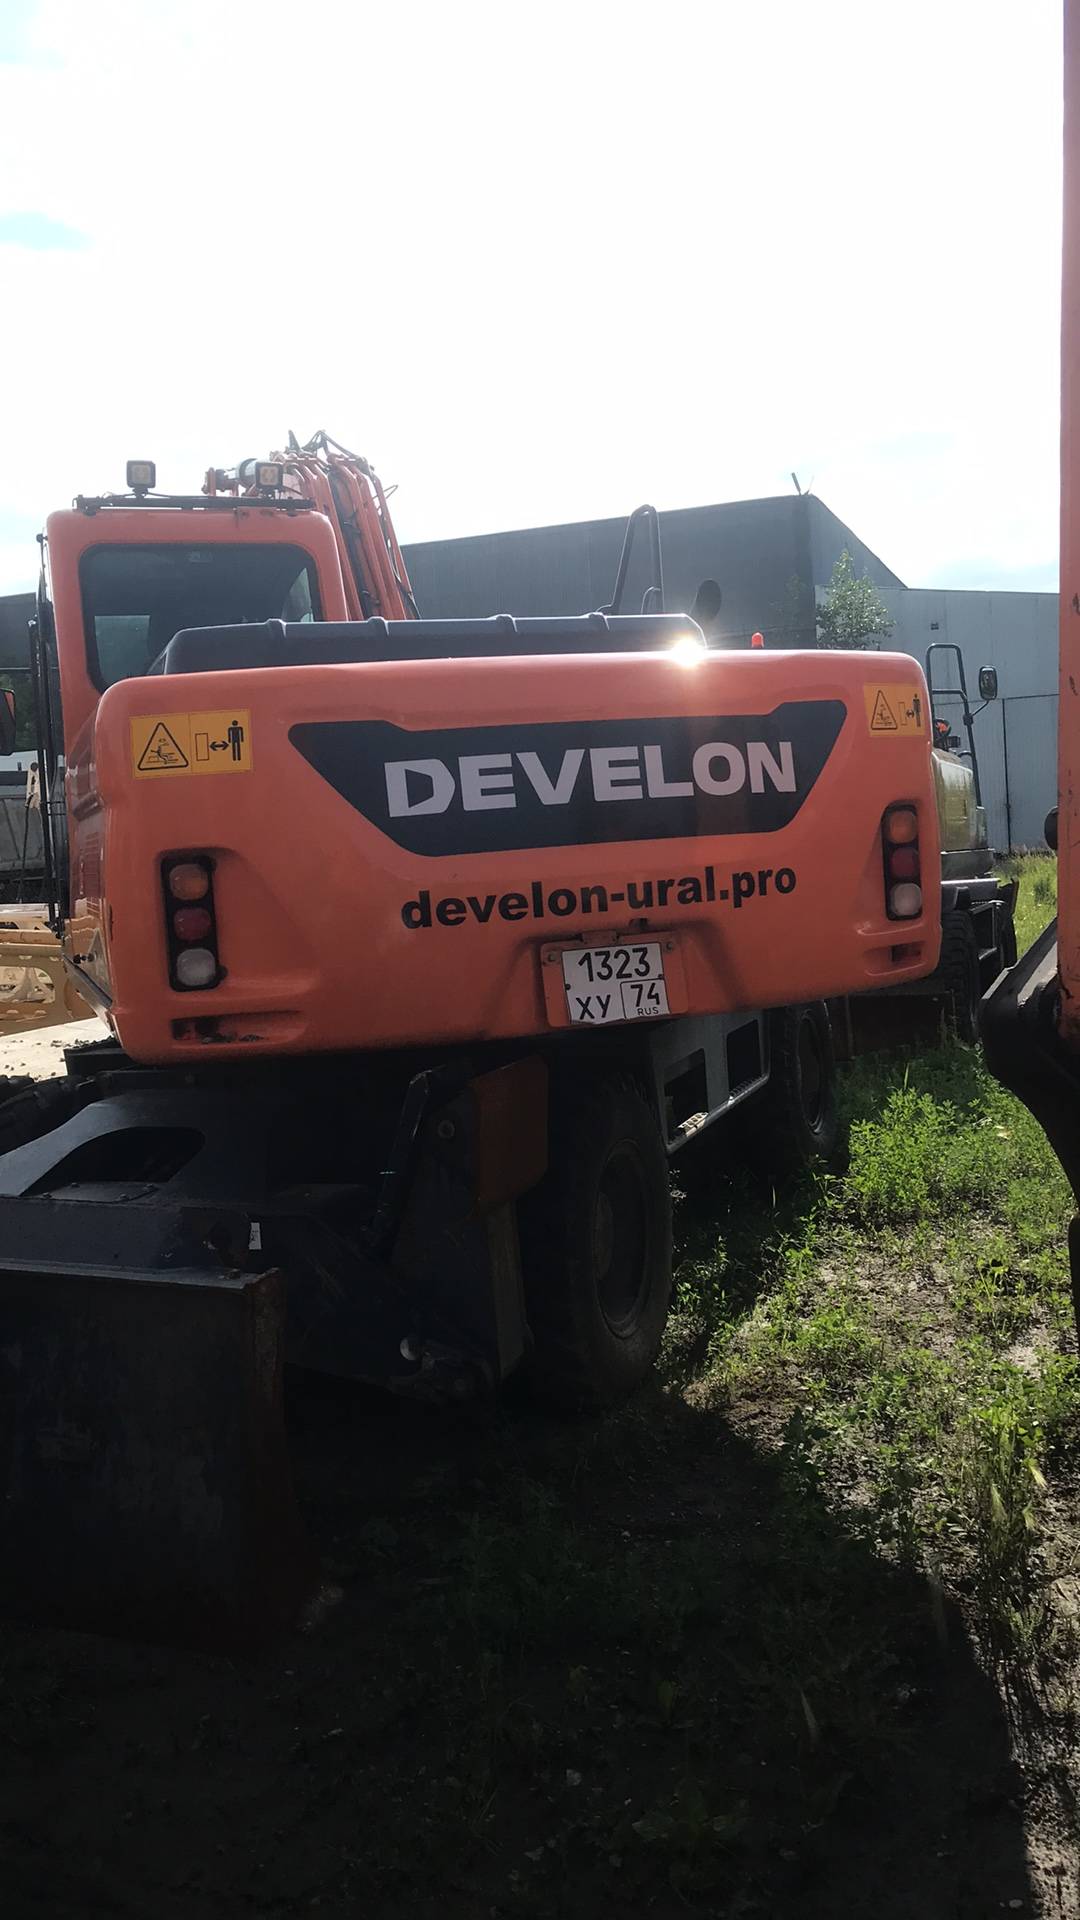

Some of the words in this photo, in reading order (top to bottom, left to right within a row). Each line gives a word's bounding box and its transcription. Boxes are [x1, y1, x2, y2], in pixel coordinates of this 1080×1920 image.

[384, 741, 796, 817] DEVELON
[401, 866, 797, 929] develon-ural.pro
[578, 947, 650, 982] 1323
[631, 983, 660, 1007] 74
[638, 1007, 659, 1017] RUS
